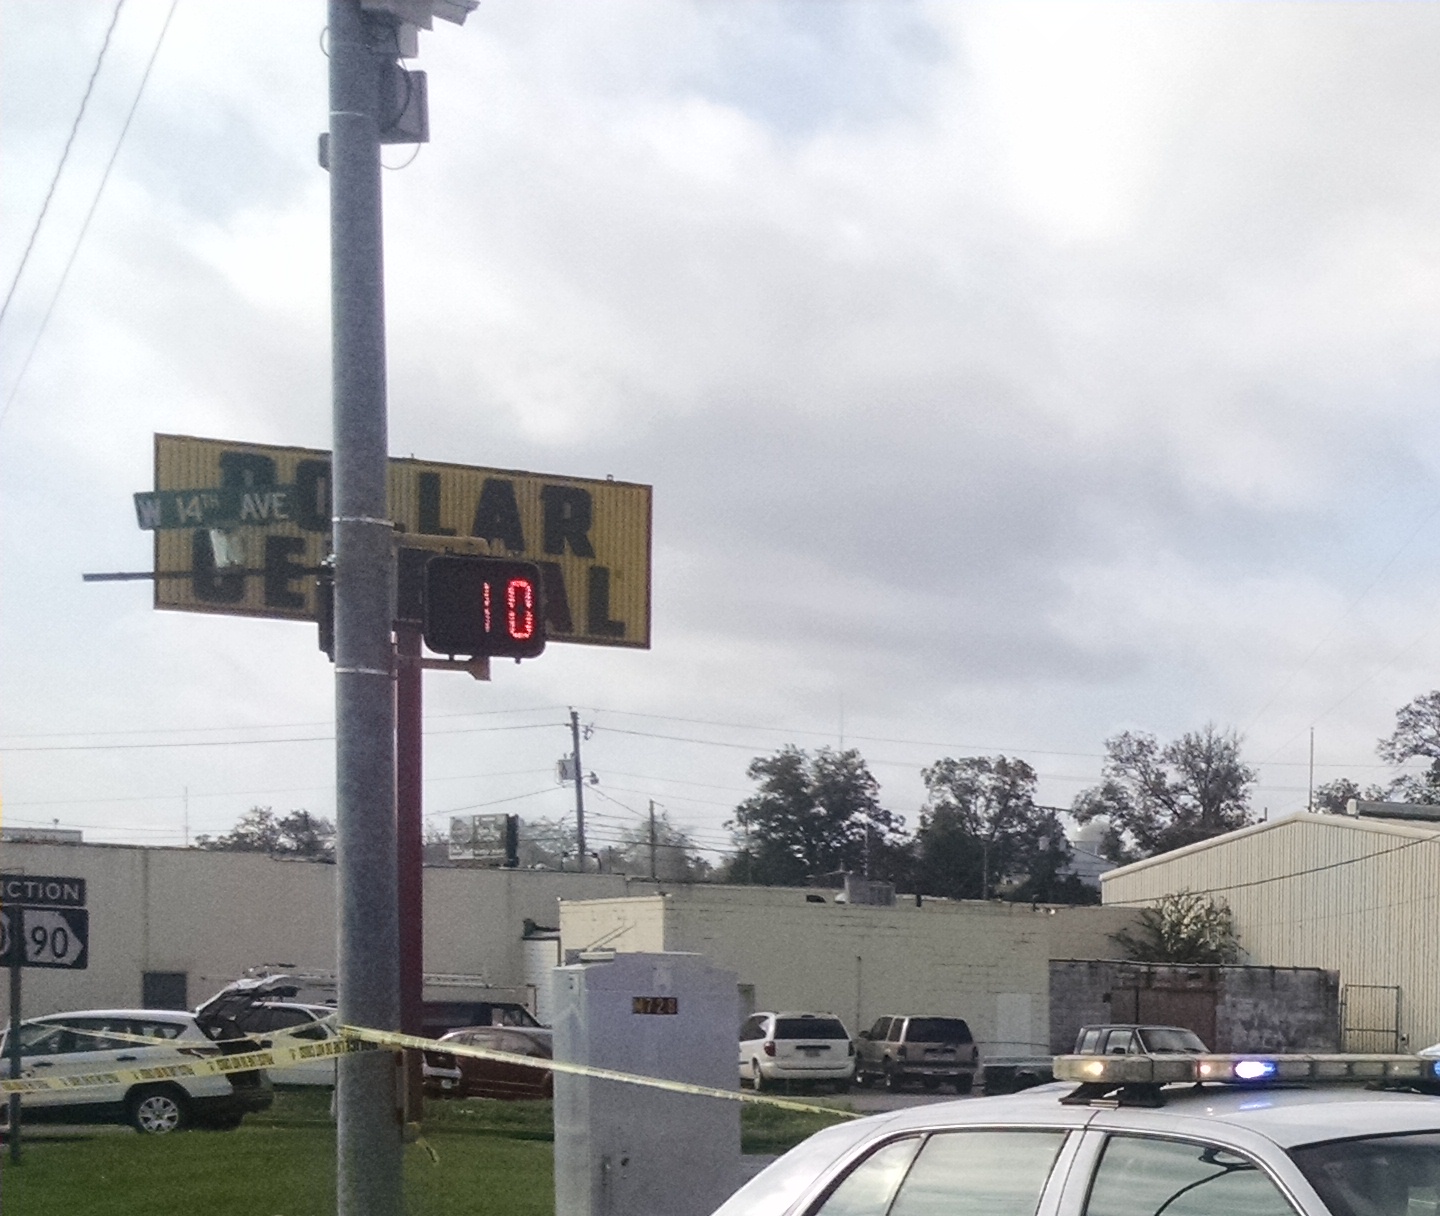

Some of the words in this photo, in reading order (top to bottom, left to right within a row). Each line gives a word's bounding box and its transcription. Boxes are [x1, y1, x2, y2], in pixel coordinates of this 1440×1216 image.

[240, 493, 290, 519] AVE
[482, 578, 532, 640] 10
[0, 881, 80, 900] CTION
[31, 926, 68, 958] 90
